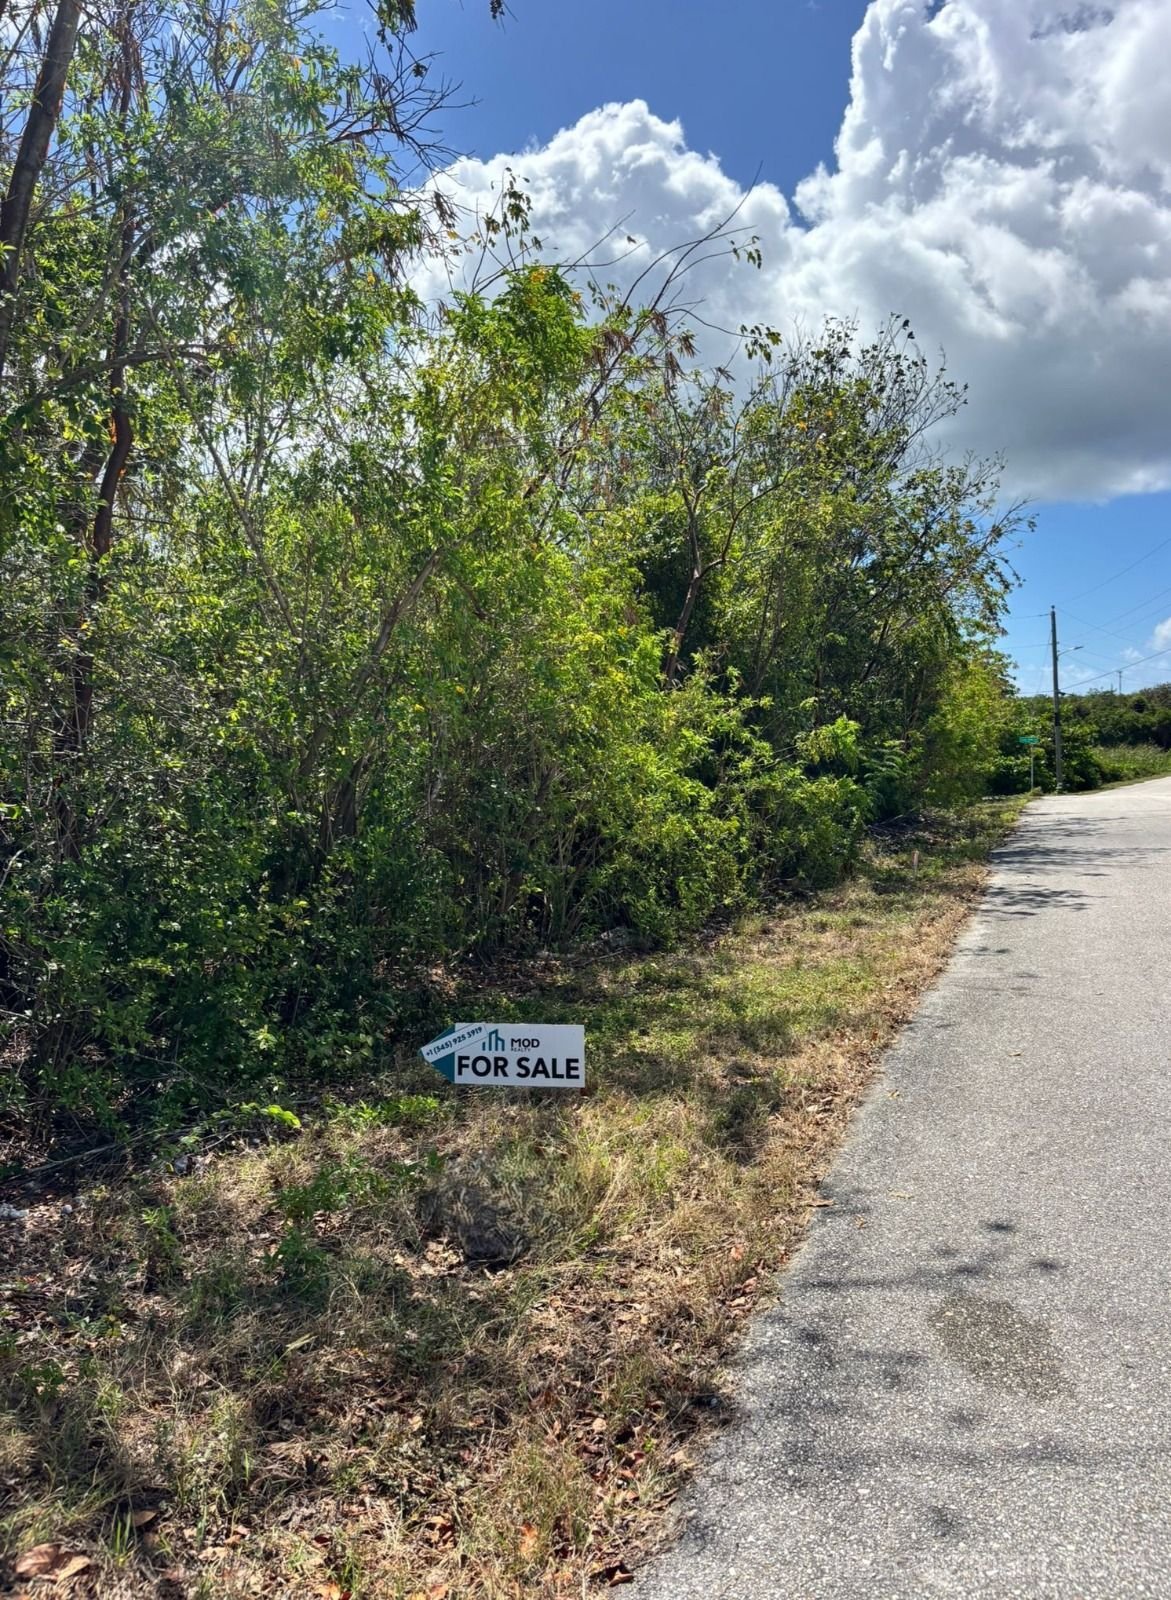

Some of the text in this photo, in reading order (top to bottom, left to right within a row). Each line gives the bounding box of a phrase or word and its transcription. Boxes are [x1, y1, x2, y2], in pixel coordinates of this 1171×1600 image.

[452, 1034, 467, 1045] 925
[467, 1026, 483, 1039] 3919
[510, 1038, 540, 1048] MOD
[457, 1055, 580, 1079] FOR SALE
